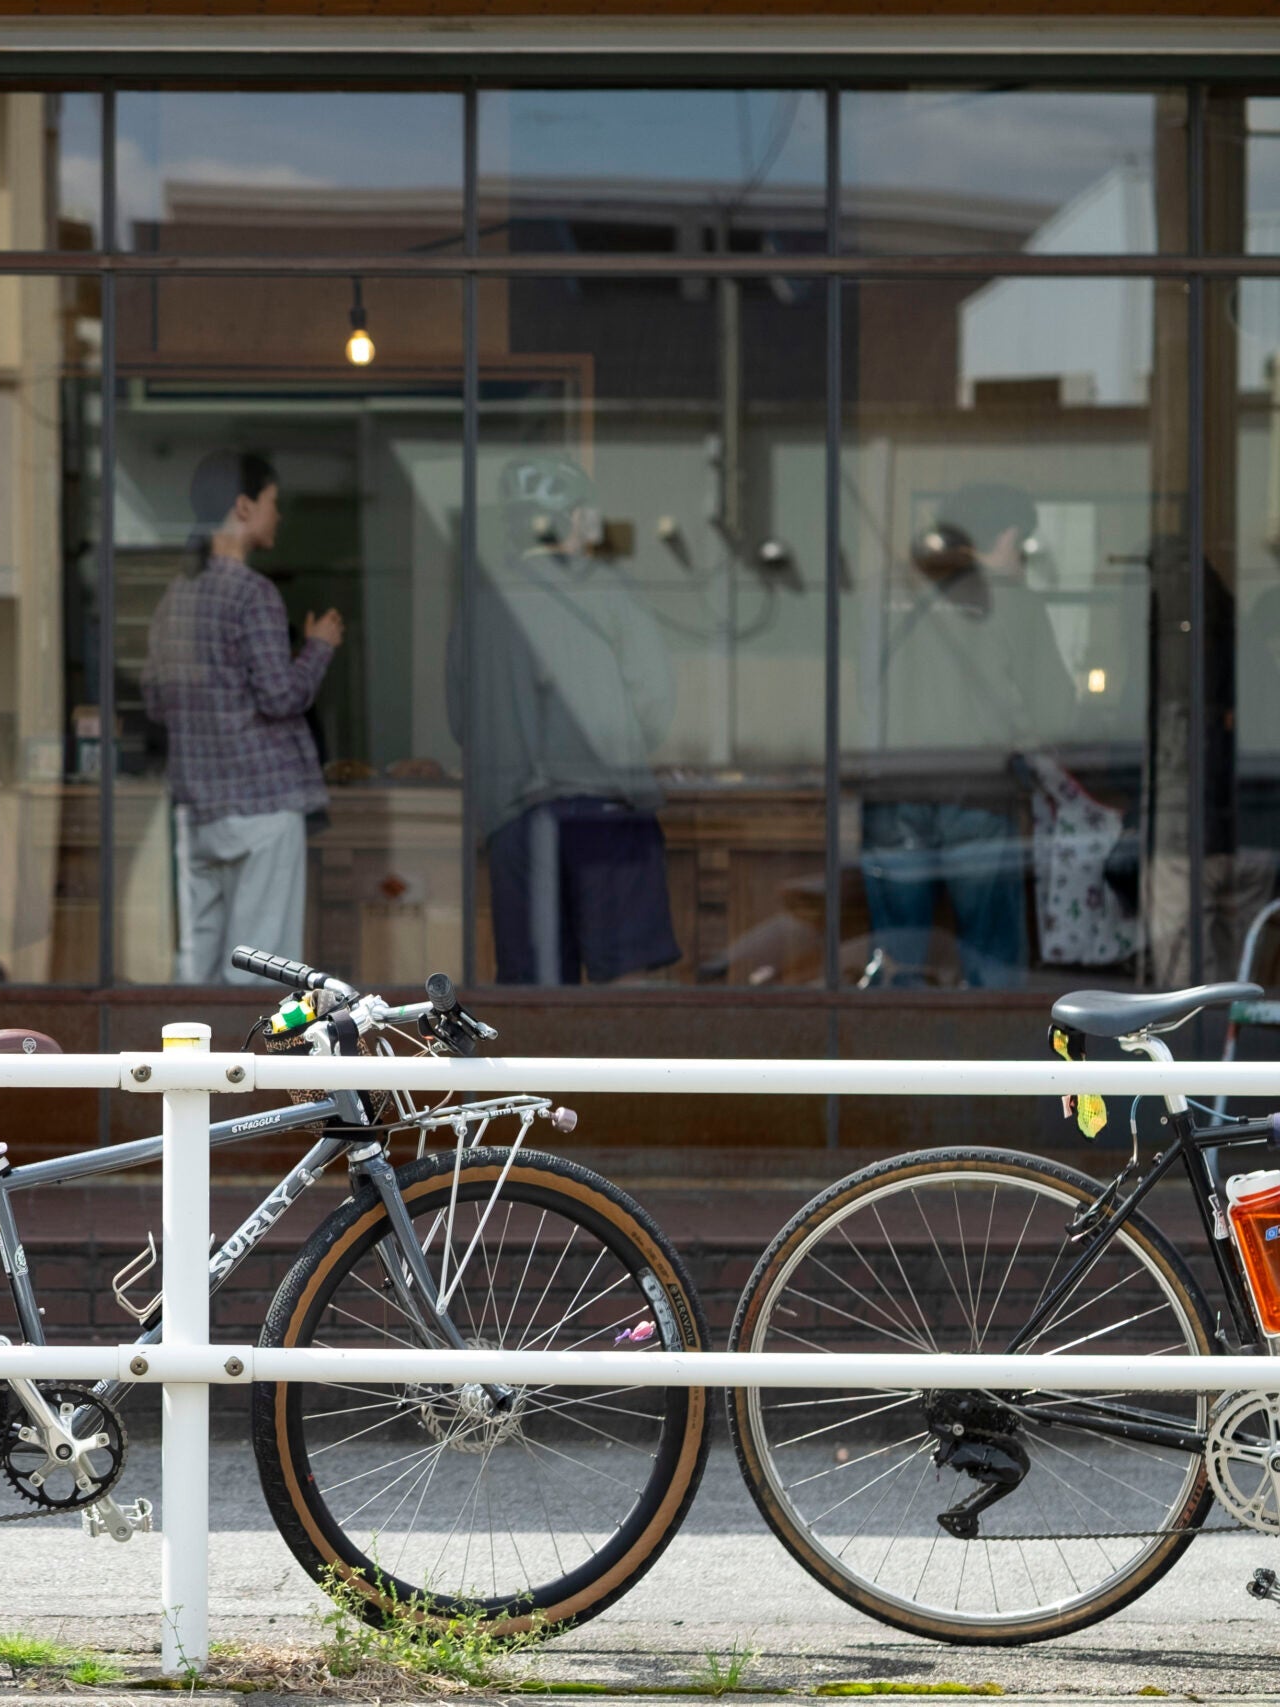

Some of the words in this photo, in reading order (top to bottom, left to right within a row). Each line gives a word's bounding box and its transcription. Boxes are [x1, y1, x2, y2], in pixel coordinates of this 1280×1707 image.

[231, 1115, 281, 1134] STRAGGLER
[209, 1184, 293, 1280] SURLY
[674, 1295, 694, 1345] TERAVAIL
